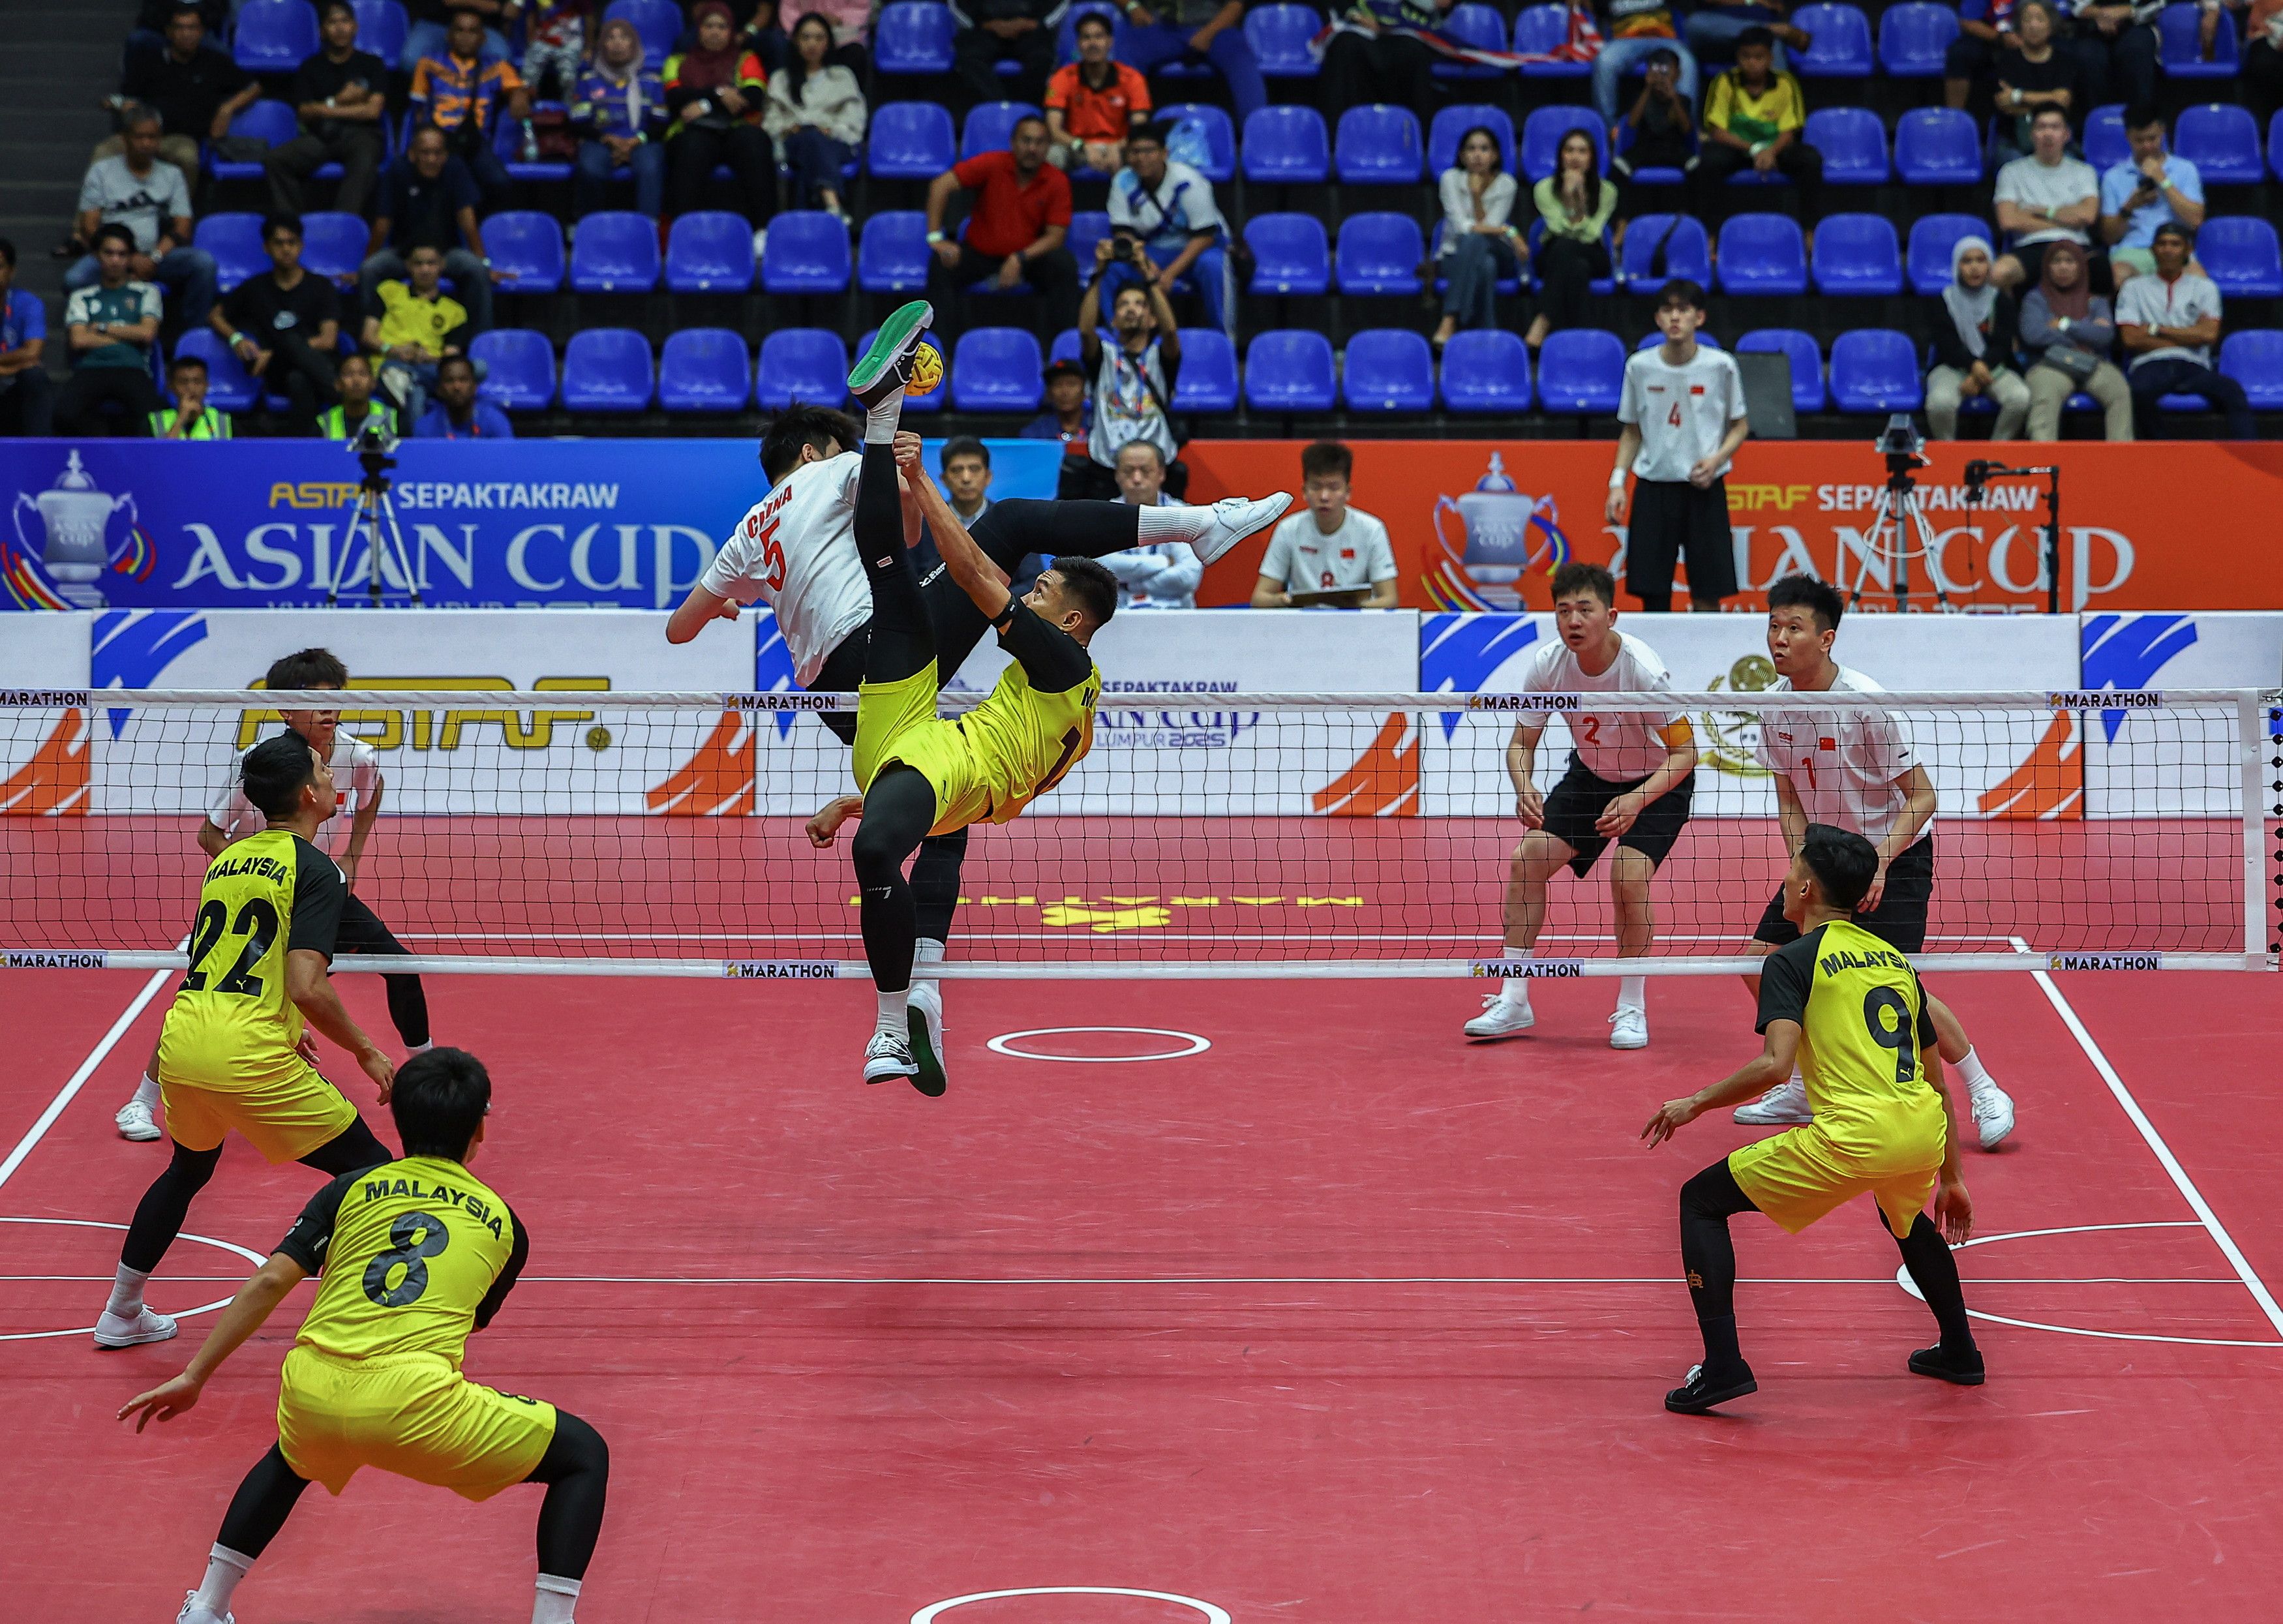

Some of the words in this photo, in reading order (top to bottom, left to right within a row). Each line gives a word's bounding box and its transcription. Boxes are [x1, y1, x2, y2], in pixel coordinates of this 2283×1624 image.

[1668, 400, 1681, 429] 4
[269, 482, 393, 509] ASTA
[399, 482, 620, 509] SEPAKTAKRAW
[1726, 485, 1813, 511] STAF
[1817, 485, 2040, 512] SEPATAKAW
[172, 522, 479, 591] ASIAN
[759, 517, 787, 592] 5
[742, 696, 836, 710] MARATHON
[1484, 696, 1578, 710] MARATHON
[2064, 693, 2158, 707] MARATHON
[1582, 717, 1600, 745] 2
[1801, 757, 1817, 789] 1
[204, 857, 288, 887] MALAYSIA
[849, 895, 1365, 907] MARATH
[10, 954, 103, 968] MARATHON
[179, 897, 279, 998] 22
[741, 964, 835, 978] MARATHON
[1487, 964, 1580, 978] MARATHON
[2064, 957, 2158, 970] MARATHON
[1863, 985, 1916, 1083] 9
[365, 1179, 503, 1242] MALAYSIA
[362, 1210, 449, 1308] 8
